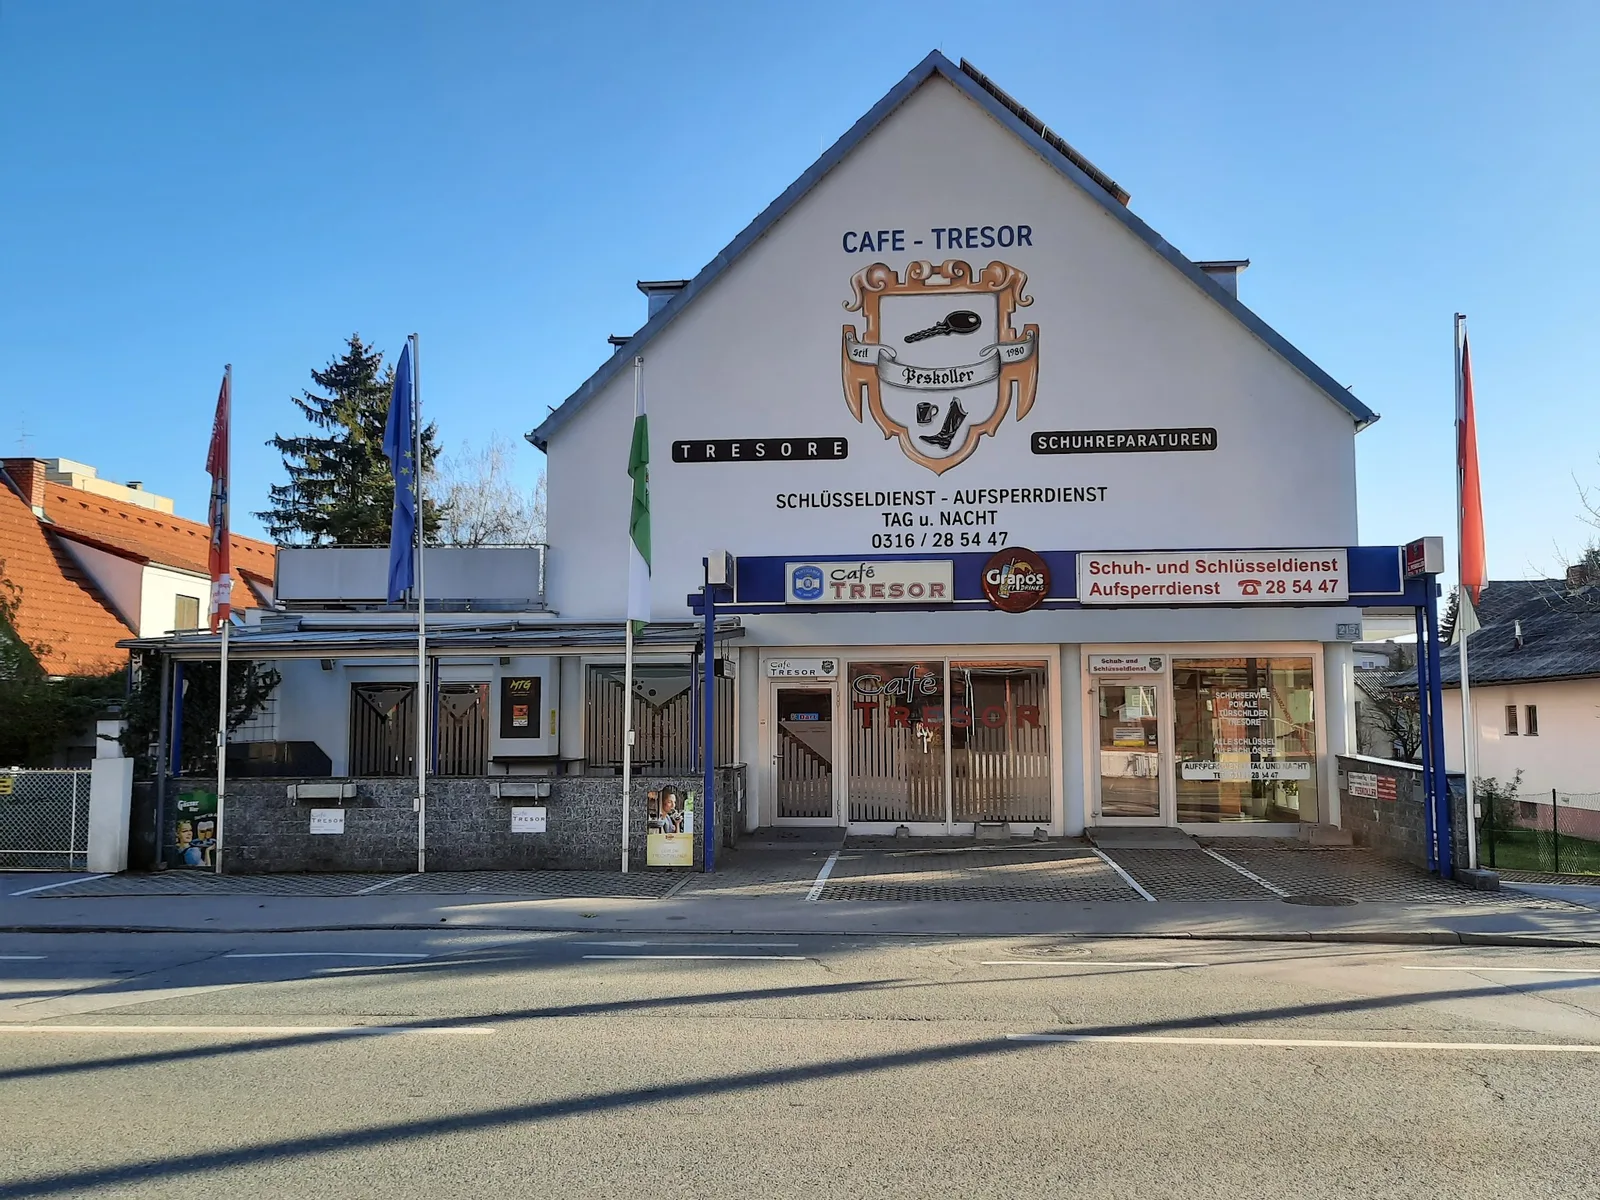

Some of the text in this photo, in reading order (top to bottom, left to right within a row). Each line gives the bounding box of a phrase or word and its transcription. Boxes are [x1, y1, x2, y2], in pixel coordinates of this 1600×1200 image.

[842, 229, 905, 254] CAFE
[931, 225, 1033, 250] TRESOR
[1006, 346, 1025, 358] 1980
[901, 367, 974, 385] Peskoller
[1037, 431, 1214, 449] SCHUHREPARATUREN
[681, 441, 843, 459] TRESORE
[775, 489, 936, 509] SCHLÜSSELDIENST
[953, 486, 1108, 505] AUFSPERRDIENST
[881, 510, 998, 527] TAG u. NACHT
[871, 533, 914, 549] 0316
[932, 532, 954, 548] 28
[960, 532, 981, 547] 54
[987, 531, 1008, 547] 47
[830, 563, 875, 583] Café
[1089, 558, 1338, 575] Schuh- und Schlüsseldienst
[986, 569, 1044, 591] Grapos
[1089, 579, 1338, 599] Aufsperrdienst 28 54 47
[829, 581, 947, 600] TRESOR
[770, 668, 816, 676] TRESOR
[510, 680, 532, 691] MTG
[852, 665, 938, 703] Café
[1215, 691, 1271, 700] SCHUHSERVICE
[1228, 700, 1258, 708] POKALE
[854, 701, 1042, 729] TRESOR
[1219, 708, 1269, 717] TÜRSCHILDER
[1228, 718, 1261, 726] TRESORE
[1233, 736, 1275, 745] SCHLÜSSEL
[1251, 771, 1260, 779] 28
[1271, 771, 1279, 779] 47
